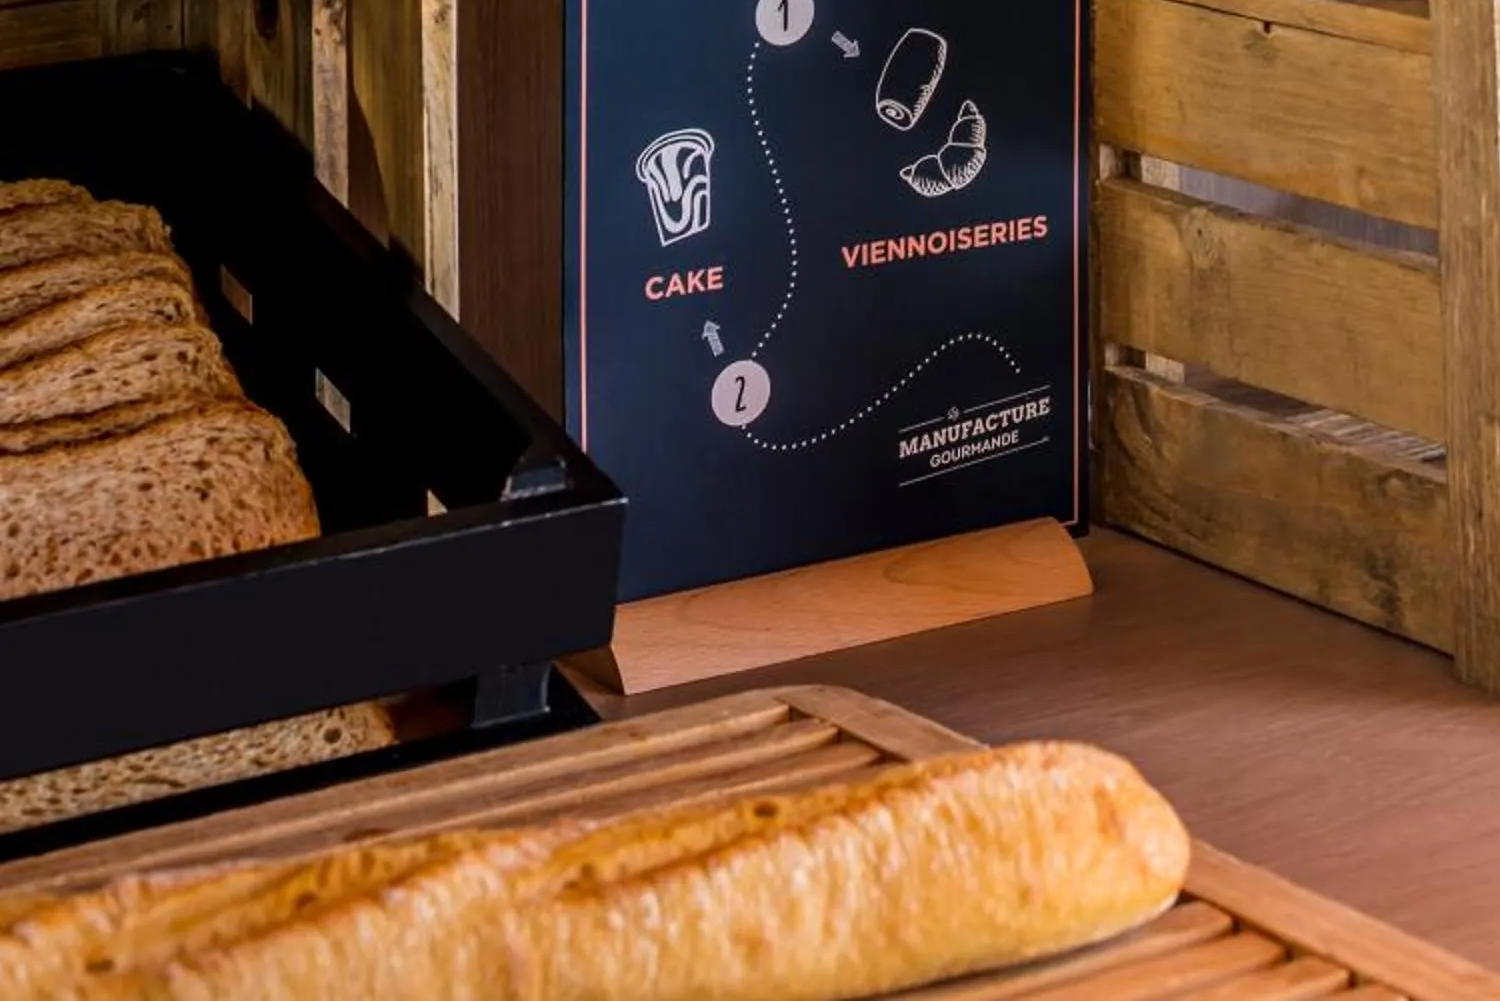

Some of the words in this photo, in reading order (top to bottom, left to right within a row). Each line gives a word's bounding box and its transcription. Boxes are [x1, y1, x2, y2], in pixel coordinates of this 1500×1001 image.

[841, 215, 1048, 269] VIENNOISERIES
[645, 266, 724, 301] CAKE
[734, 376, 747, 412] 2
[899, 397, 1051, 459] MANUFACTURE
[929, 430, 1020, 468] GOURMANDE
